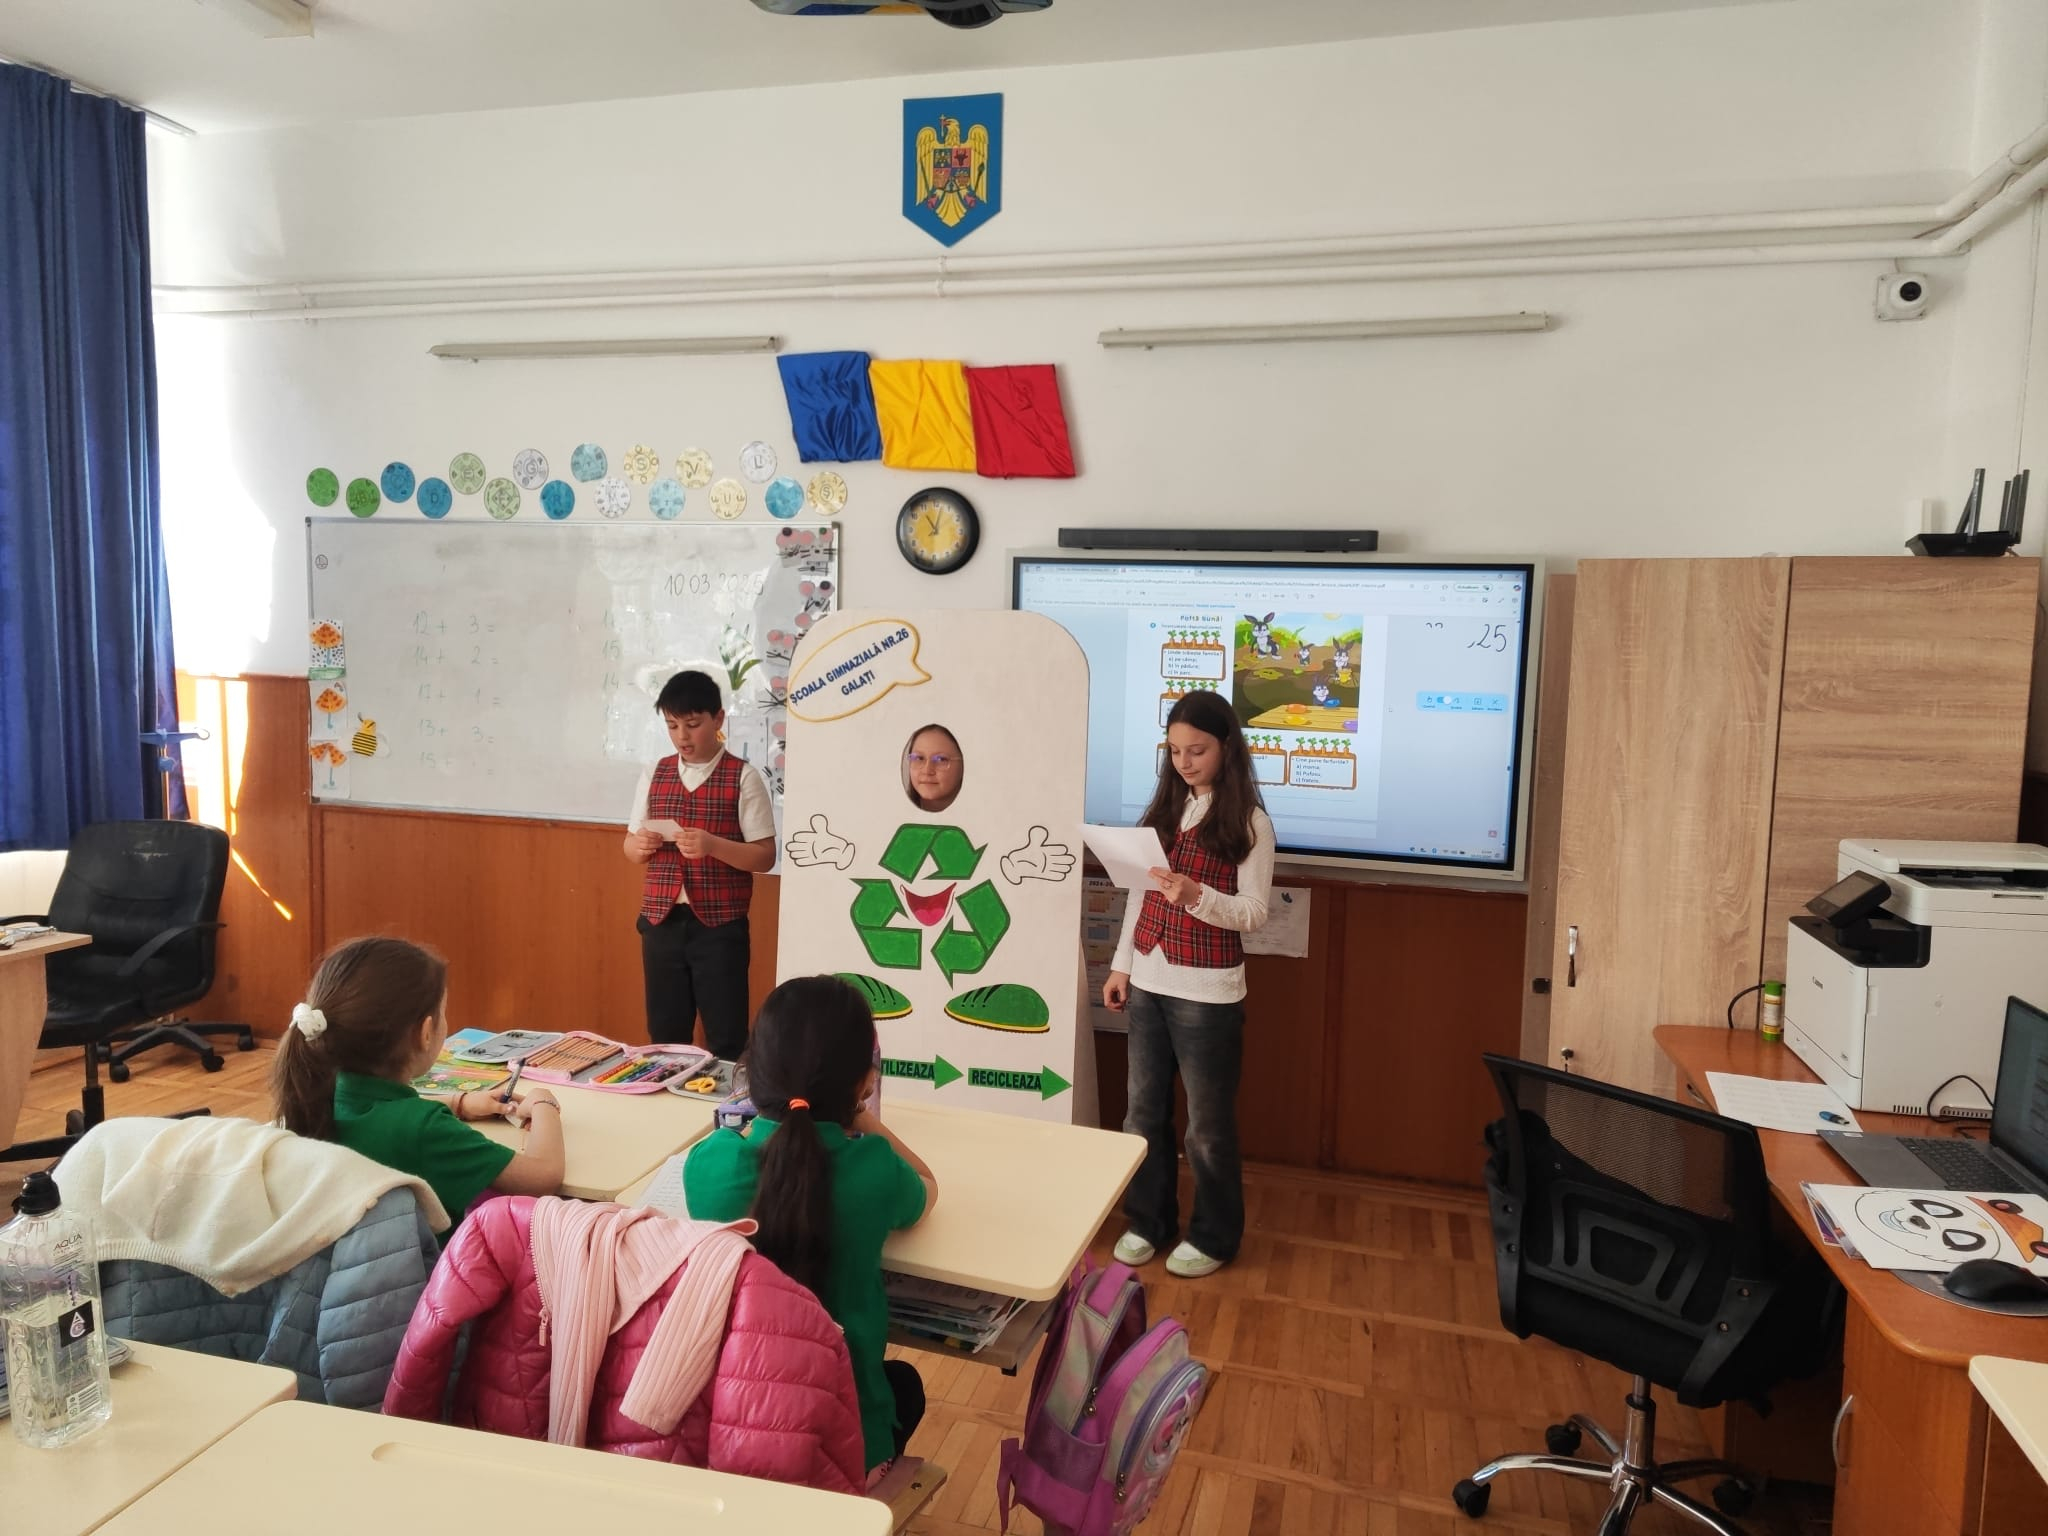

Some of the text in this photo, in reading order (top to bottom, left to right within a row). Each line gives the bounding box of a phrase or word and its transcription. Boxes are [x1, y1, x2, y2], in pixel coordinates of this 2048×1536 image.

[664, 573, 685, 597] 10
[413, 610, 431, 637] 12
[789, 628, 909, 706] ȘCOALA GIMNAZIALĂ NR.26
[841, 670, 876, 696] GALAȚI
[880, 1060, 935, 1080] TILIZEAZA
[972, 1071, 1041, 1091] RECICLEAZA
[53, 1233, 82, 1251] AQUA
